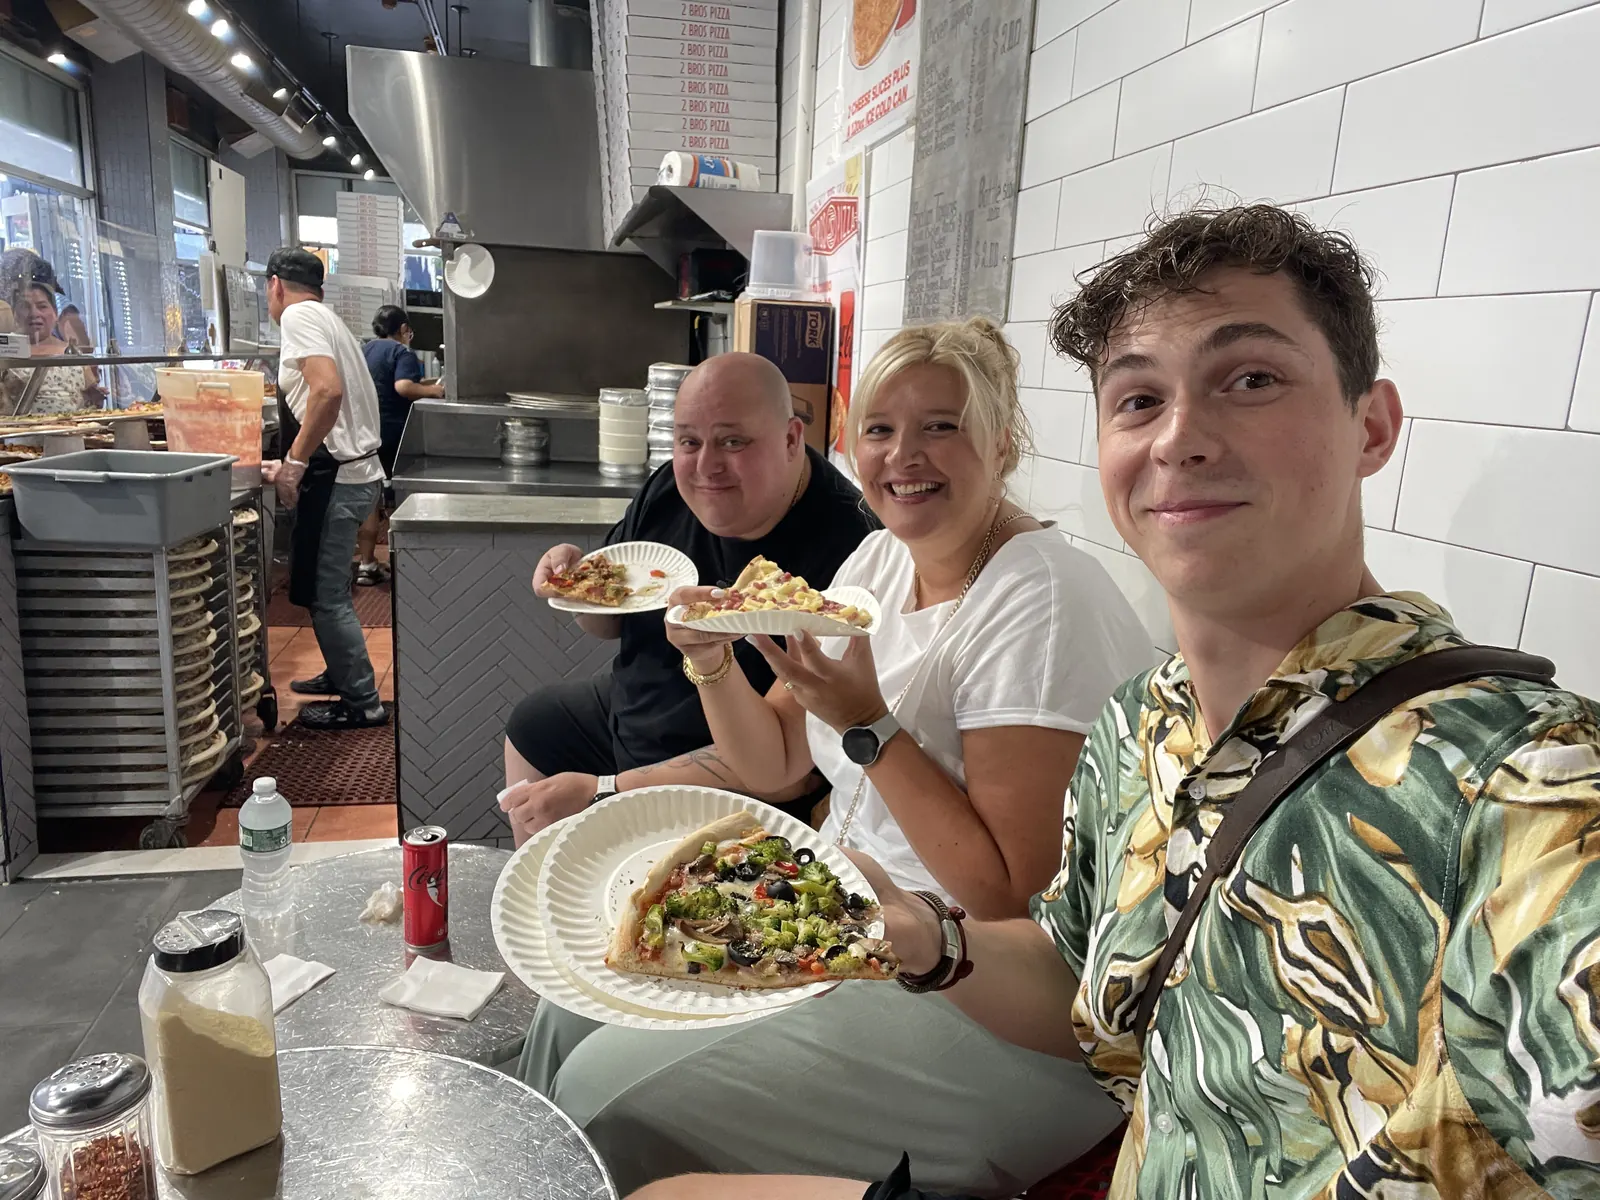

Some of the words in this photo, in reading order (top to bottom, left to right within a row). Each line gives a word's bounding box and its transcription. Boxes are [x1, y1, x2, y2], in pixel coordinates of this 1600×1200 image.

[681, 3, 687, 16] 2
[689, 4, 708, 18] BROS
[710, 6, 731, 20] PIZZA
[681, 22, 687, 36] 2
[688, 23, 707, 38] BROS
[710, 25, 730, 40] PIZZA
[680, 42, 685, 56] 2
[687, 43, 706, 57] BROS
[708, 44, 729, 59] PIZZA
[680, 61, 685, 74] 2
[687, 62, 706, 76] BROS
[708, 63, 729, 77] PIZZA
[680, 80, 686, 93] 2
[687, 81, 706, 94] BROS
[708, 82, 729, 96] PIZZA
[872, 73, 892, 100] SLICES
[893, 60, 910, 85] PLUS
[681, 98, 687, 112] 2
[689, 99, 708, 113] BROS
[710, 100, 730, 114] PIZZA
[875, 95, 892, 120] COLD
[893, 84, 908, 108] CAN
[682, 117, 688, 130] 2
[689, 118, 708, 131] BROS
[710, 119, 731, 133] PIZZA
[681, 135, 687, 148] 2
[689, 136, 708, 149] BROS
[710, 137, 730, 150] PIZZA
[807, 311, 820, 349] TORK
